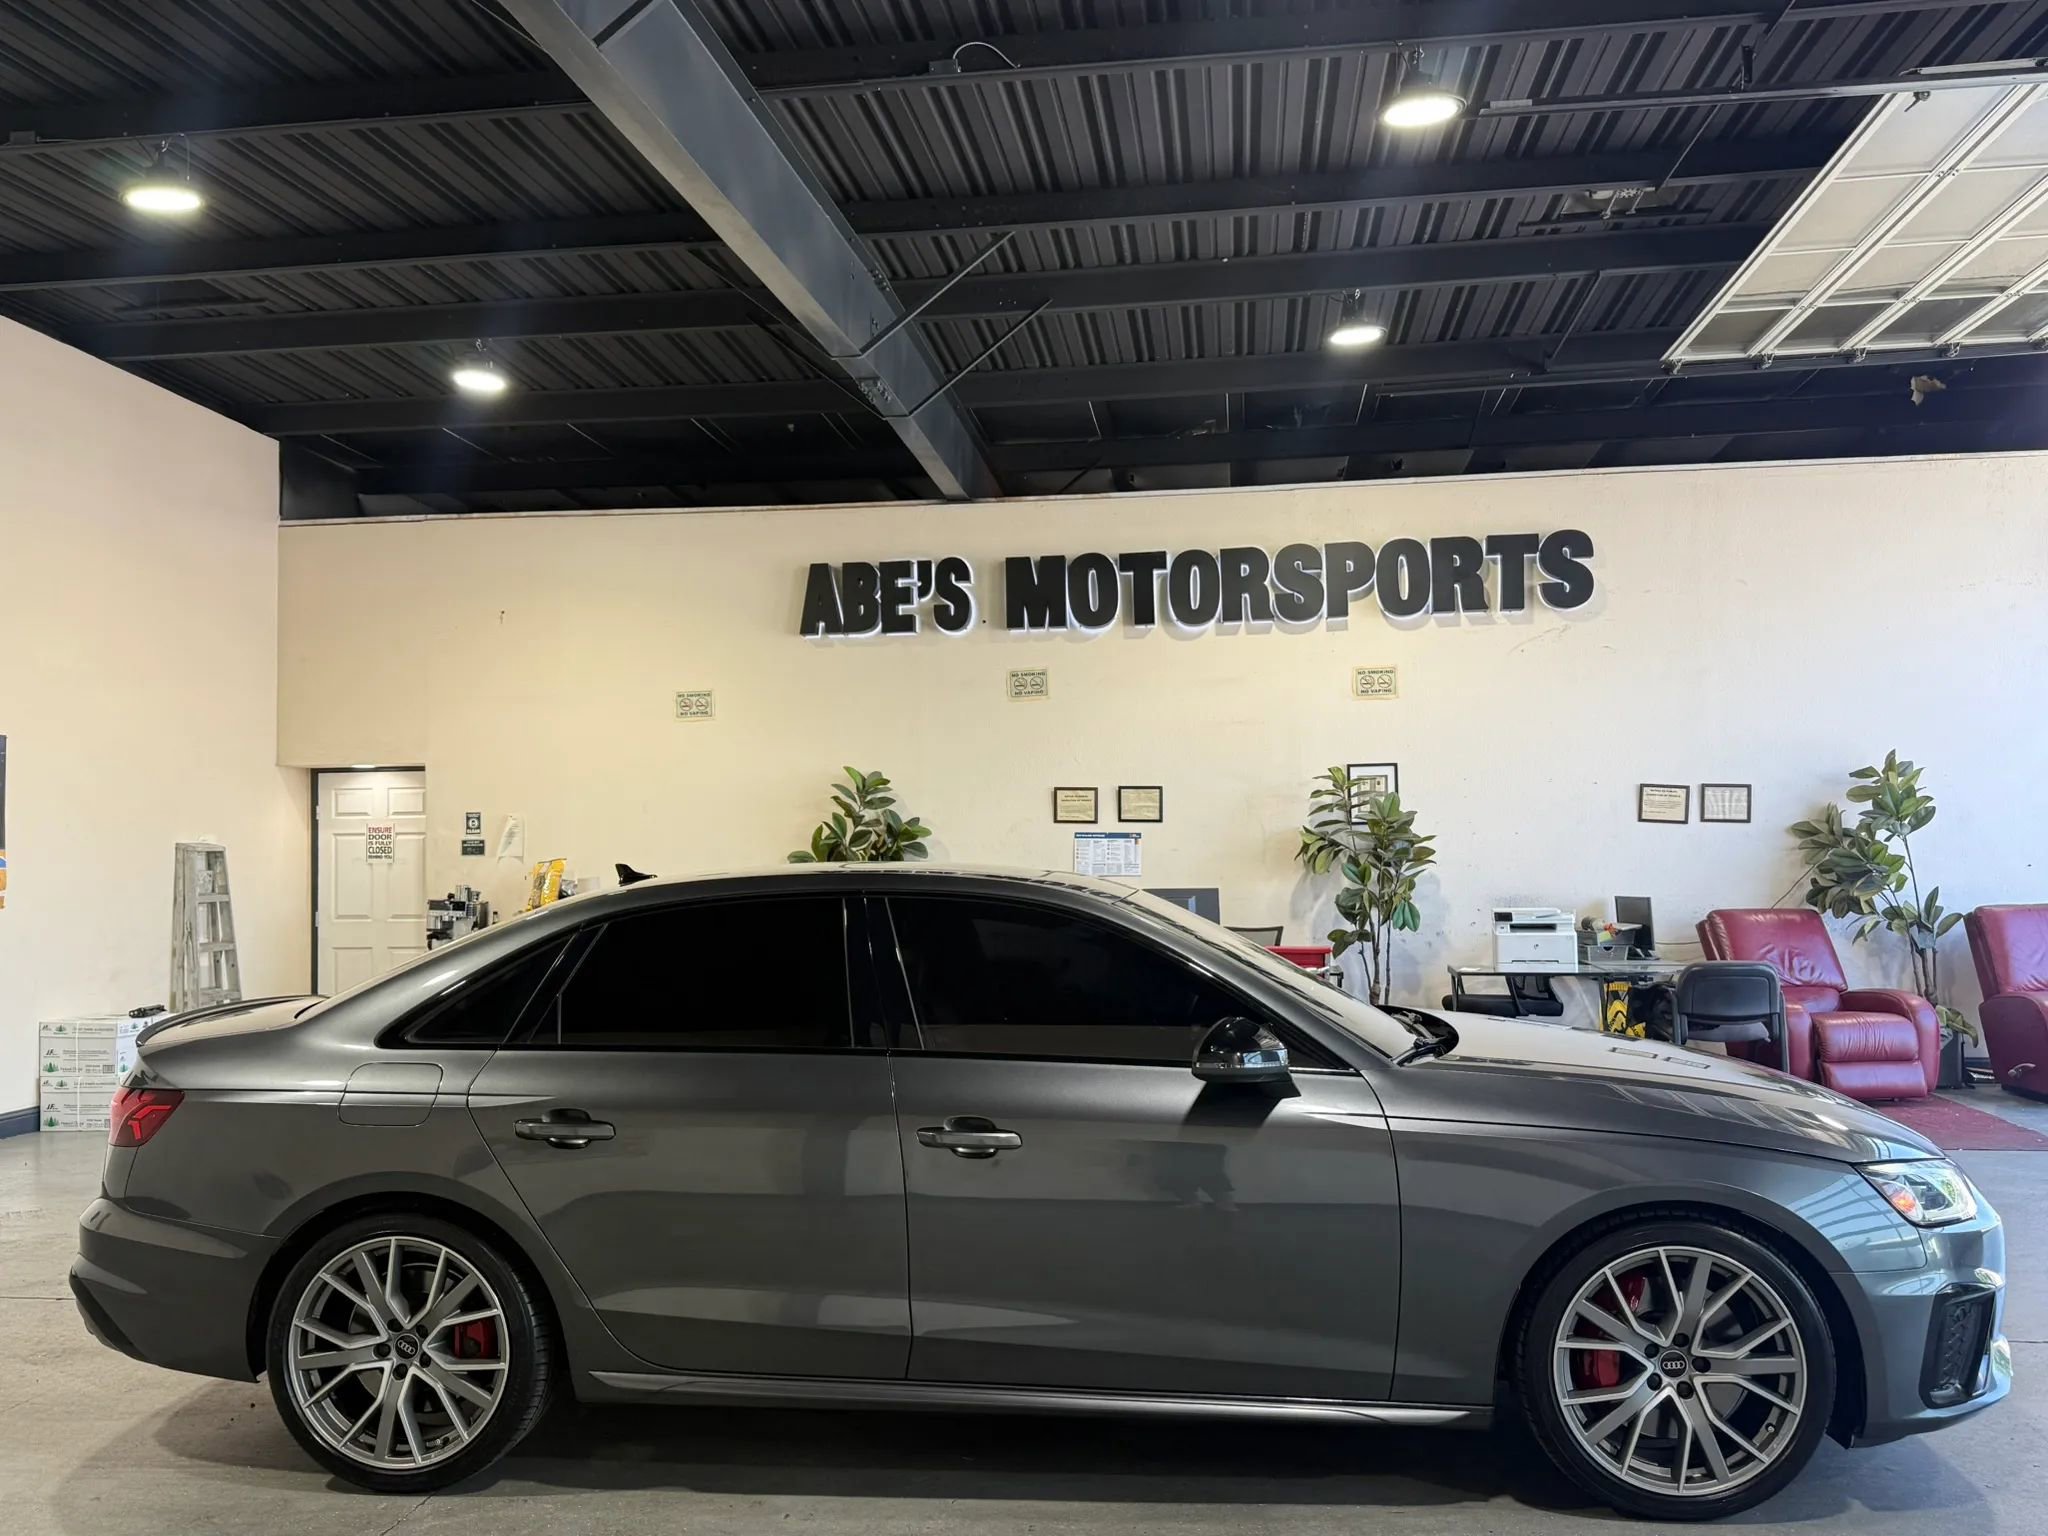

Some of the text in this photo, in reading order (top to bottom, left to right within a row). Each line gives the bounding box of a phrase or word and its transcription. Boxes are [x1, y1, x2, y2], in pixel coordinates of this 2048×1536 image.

[800, 528, 1596, 638] ABE'S MOTORSPORTS
[368, 846, 393, 854] CLOSED
